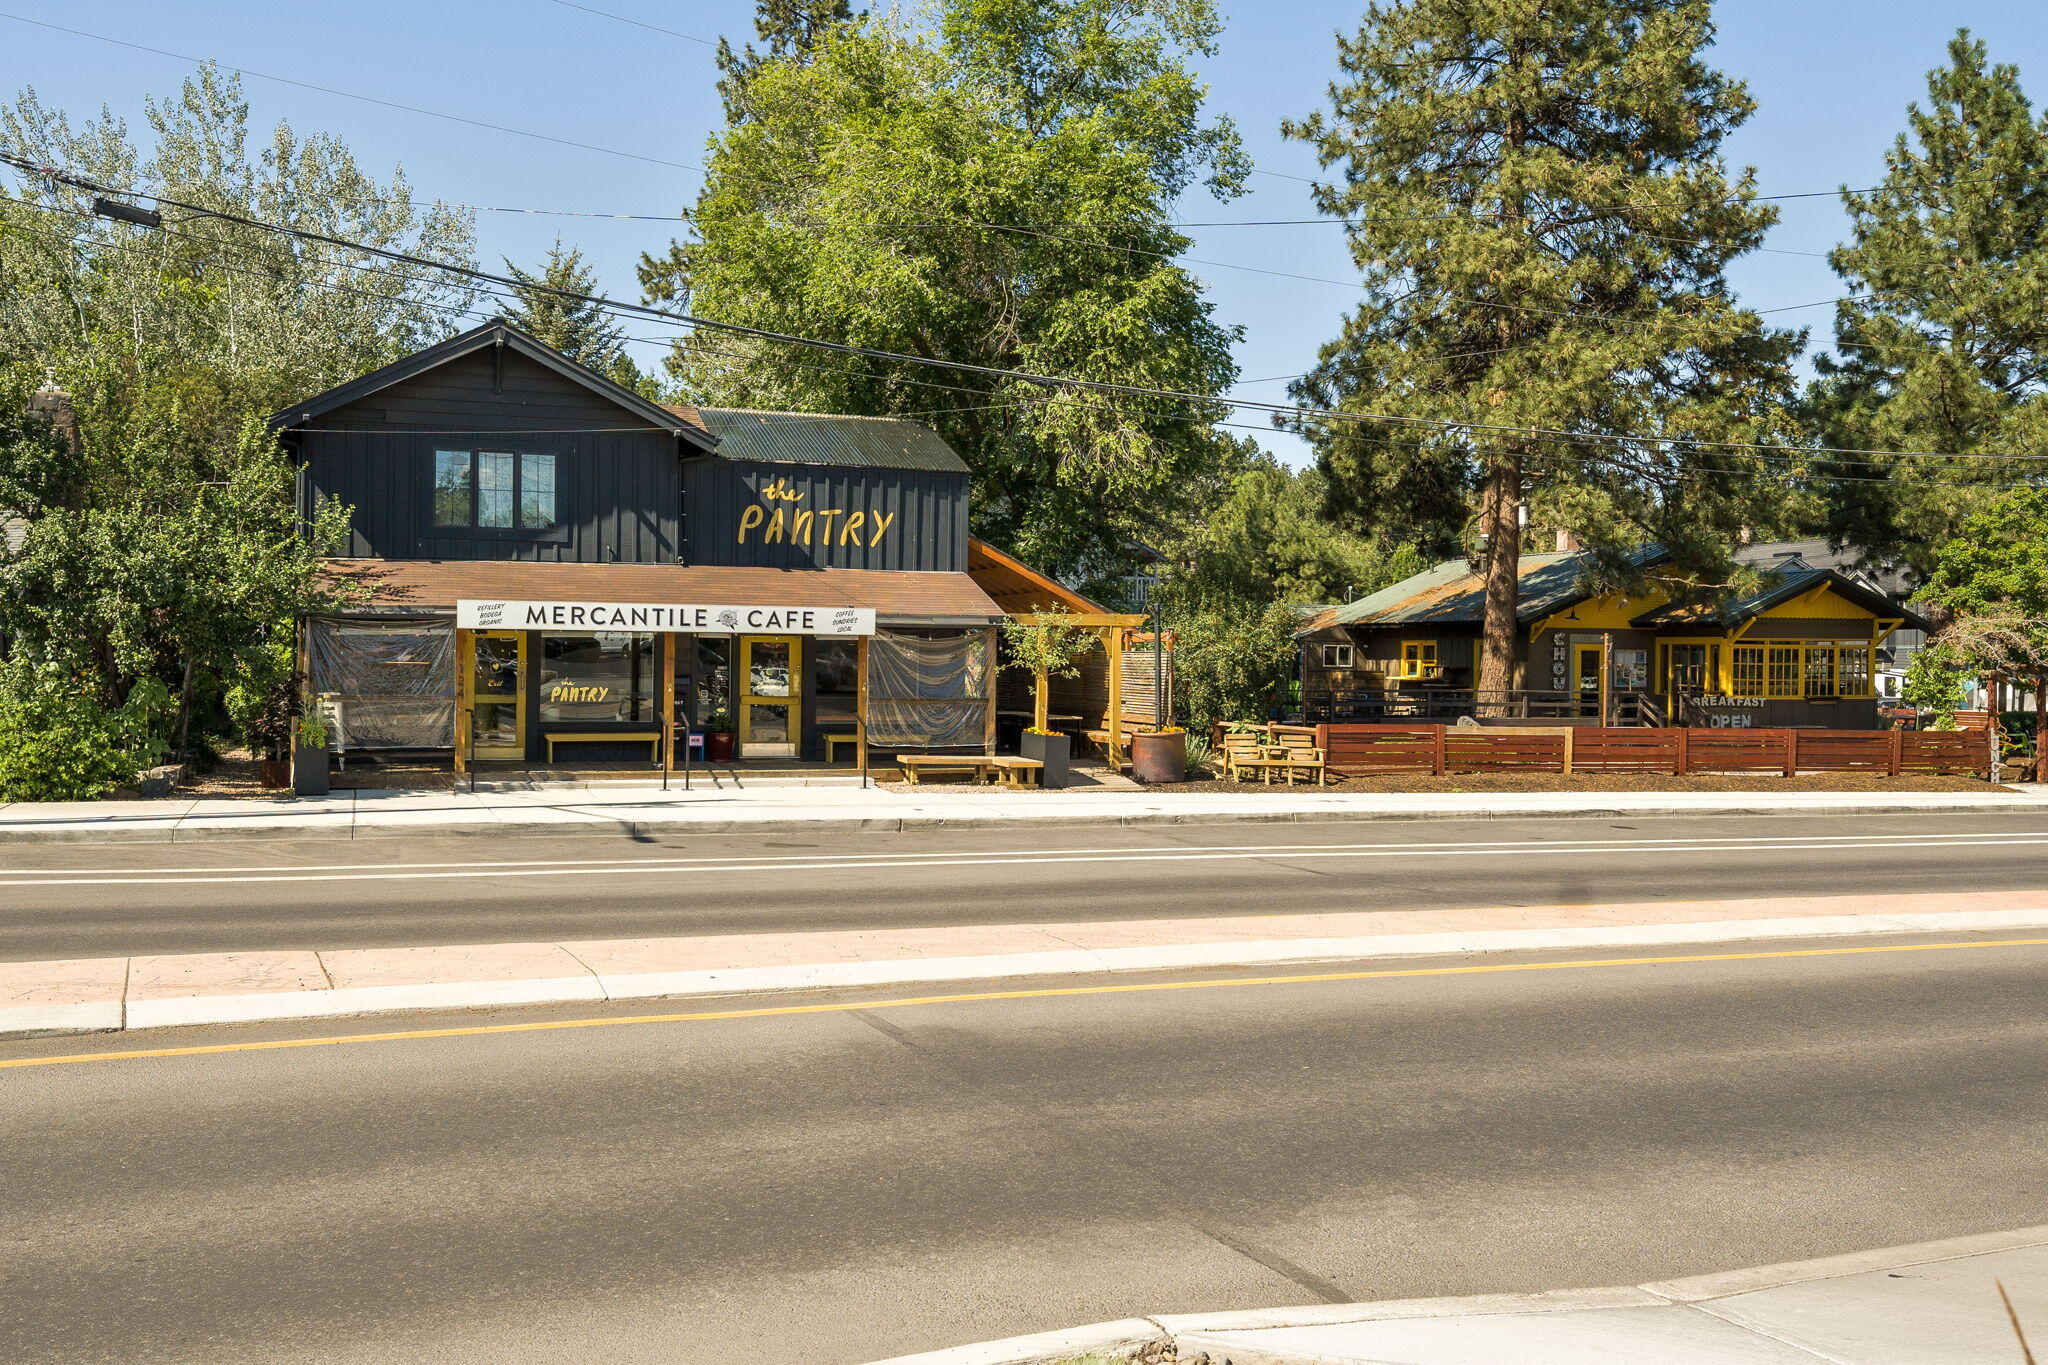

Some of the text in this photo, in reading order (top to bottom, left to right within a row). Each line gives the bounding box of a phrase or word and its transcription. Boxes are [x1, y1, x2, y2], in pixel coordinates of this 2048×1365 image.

[762, 477, 805, 501] the
[737, 504, 894, 548] PANTRY
[480, 611, 502, 619] BODEGA
[526, 606, 814, 629] MERCANTILE CAFE
[835, 610, 855, 618] COFFEE
[832, 618, 858, 626] SUNDRIES
[561, 677, 576, 686] the
[551, 686, 608, 702] PANTRY
[1710, 714, 1752, 729] OPEN
